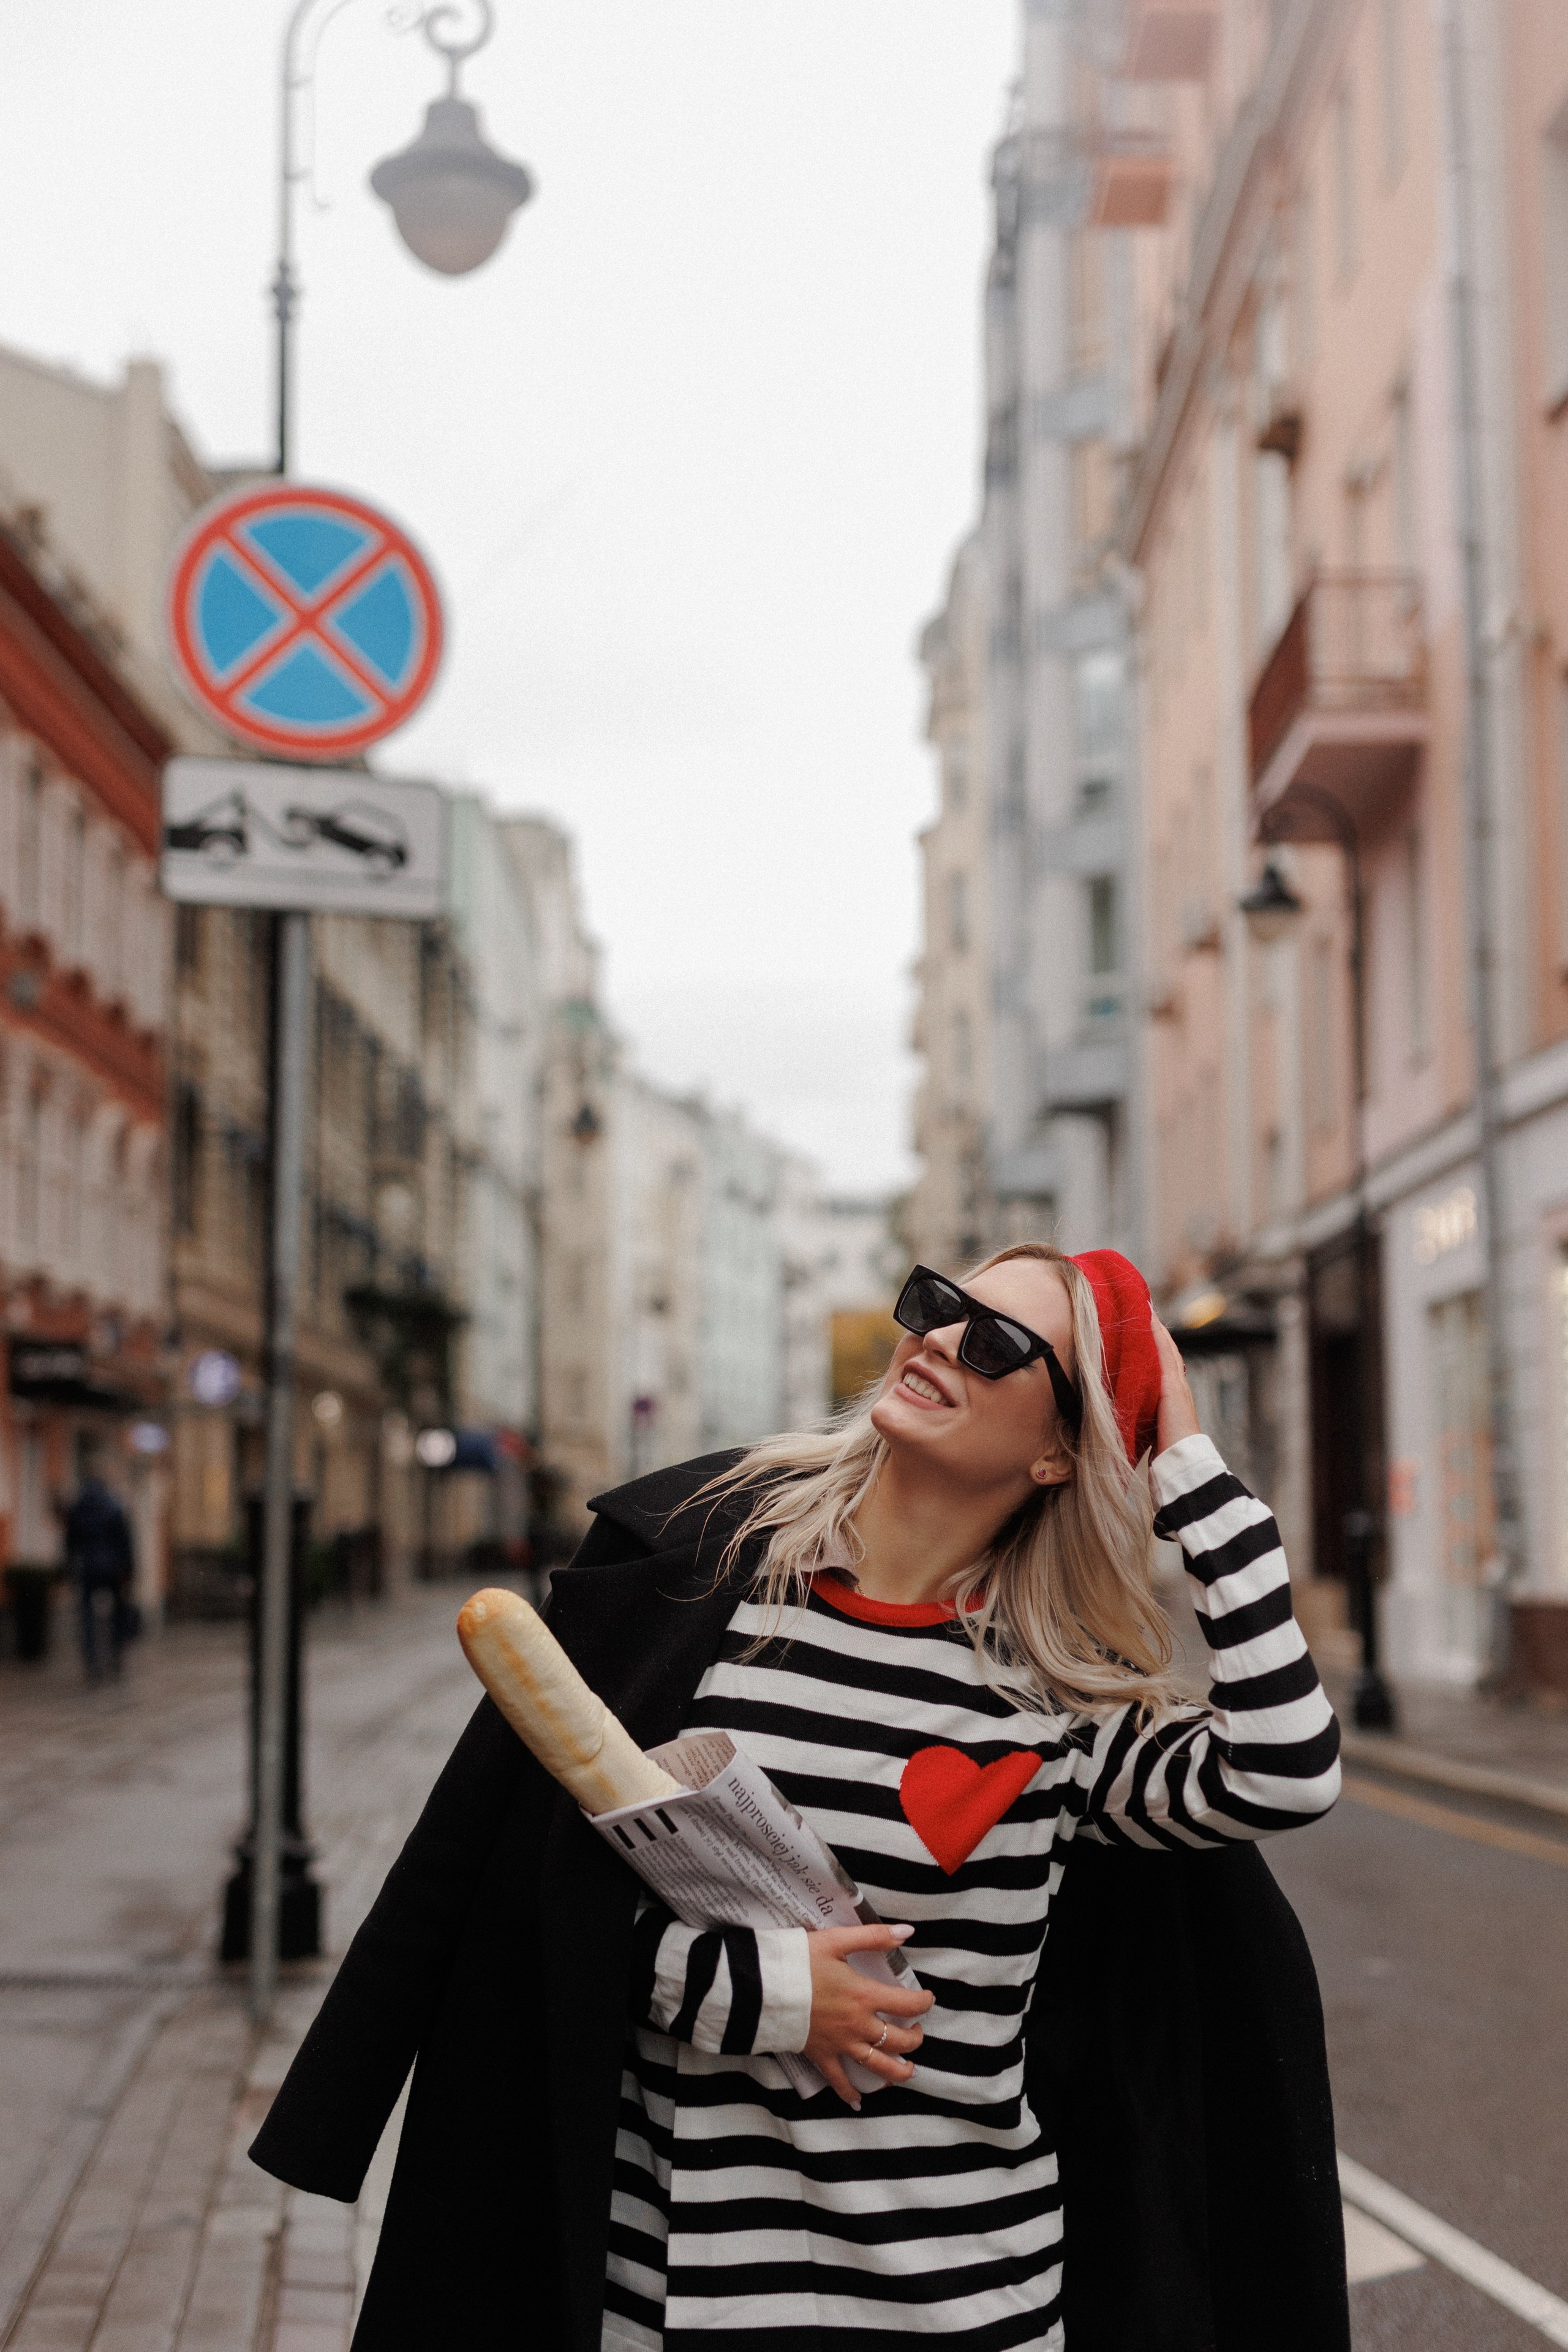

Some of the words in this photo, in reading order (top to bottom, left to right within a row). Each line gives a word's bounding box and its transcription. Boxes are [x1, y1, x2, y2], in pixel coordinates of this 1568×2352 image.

[727, 1777, 793, 1858] najprosciej
[778, 1854, 808, 1876] jak
[816, 1897, 834, 1917] da
